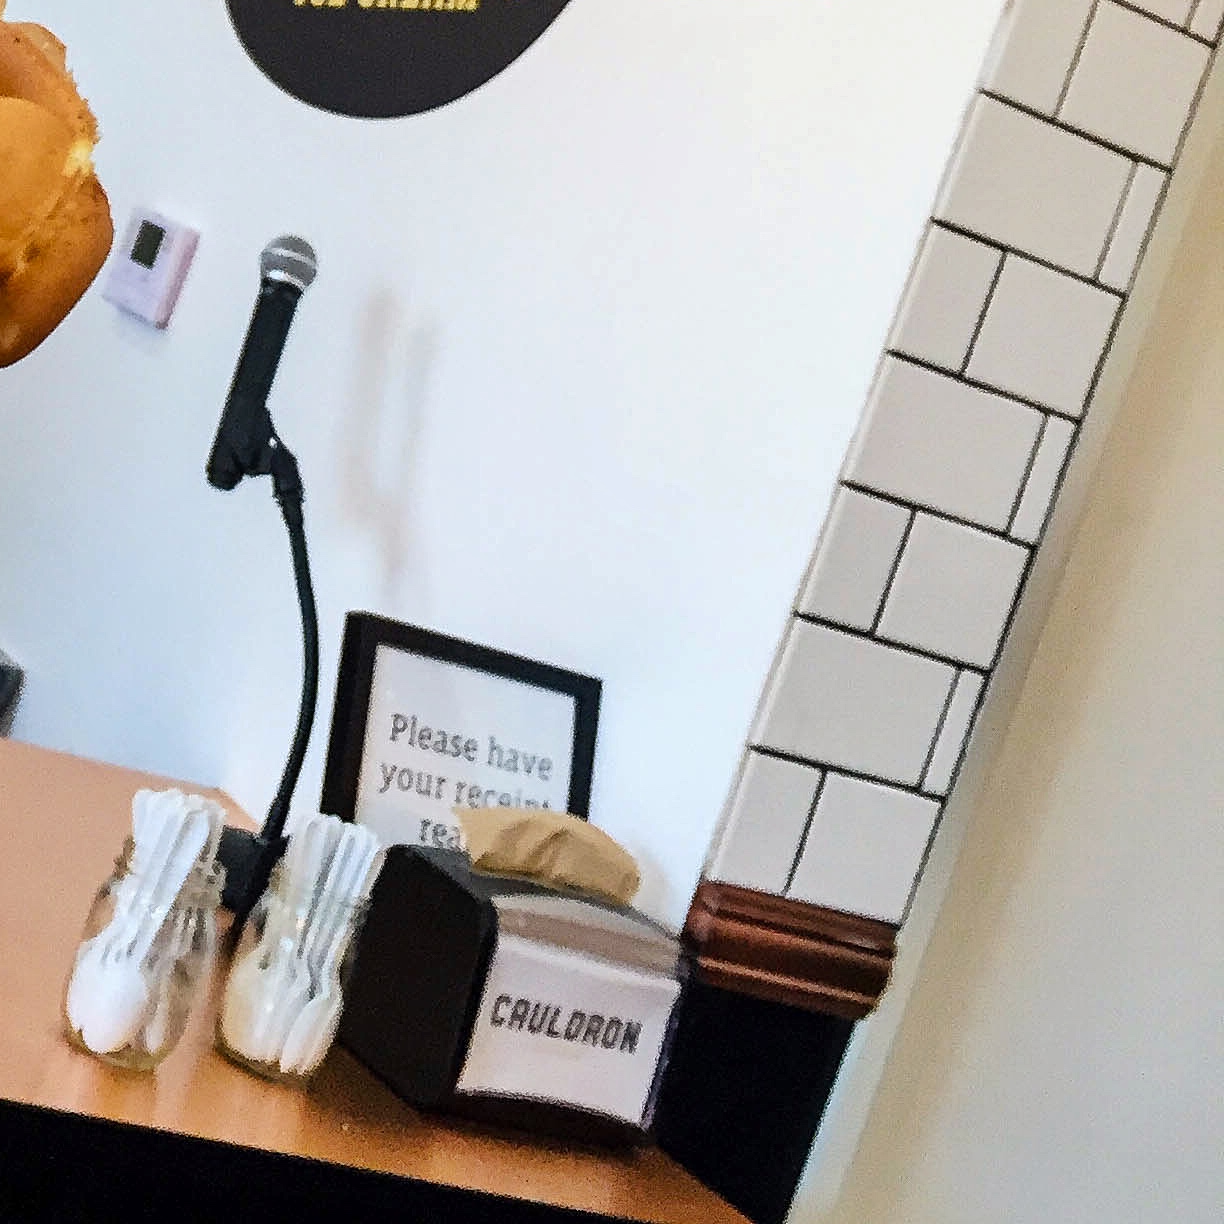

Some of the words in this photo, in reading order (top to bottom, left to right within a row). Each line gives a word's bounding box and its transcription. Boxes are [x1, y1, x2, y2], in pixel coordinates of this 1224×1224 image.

[389, 713, 479, 761] Please
[487, 735, 554, 781] have
[377, 762, 446, 800] your
[490, 992, 643, 1056] CAULDRON
